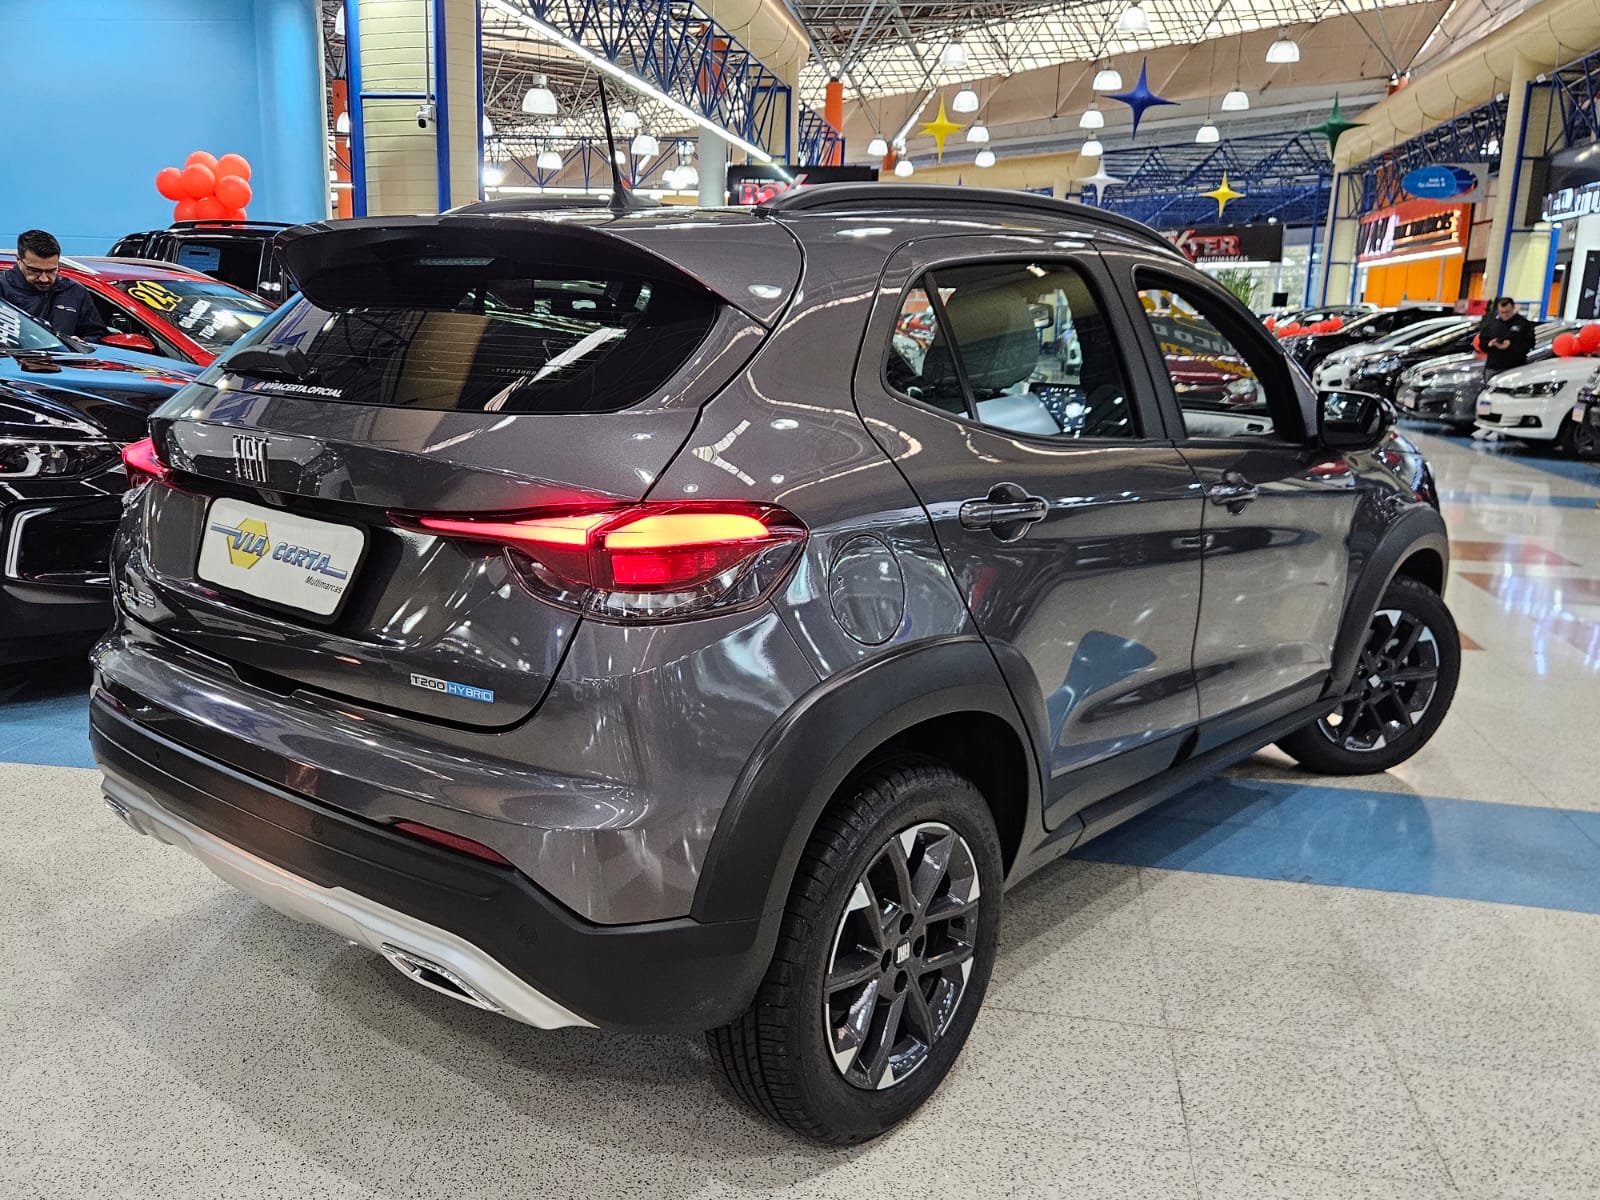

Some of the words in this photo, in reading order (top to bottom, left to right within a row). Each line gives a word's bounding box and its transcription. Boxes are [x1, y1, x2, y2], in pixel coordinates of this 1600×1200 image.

[232, 435, 269, 483] FIAT
[231, 530, 267, 557] VIA
[271, 541, 332, 573] CERTA
[304, 574, 344, 594] Multimarcas
[412, 675, 445, 691] T200
[448, 683, 492, 701] HYBRID
